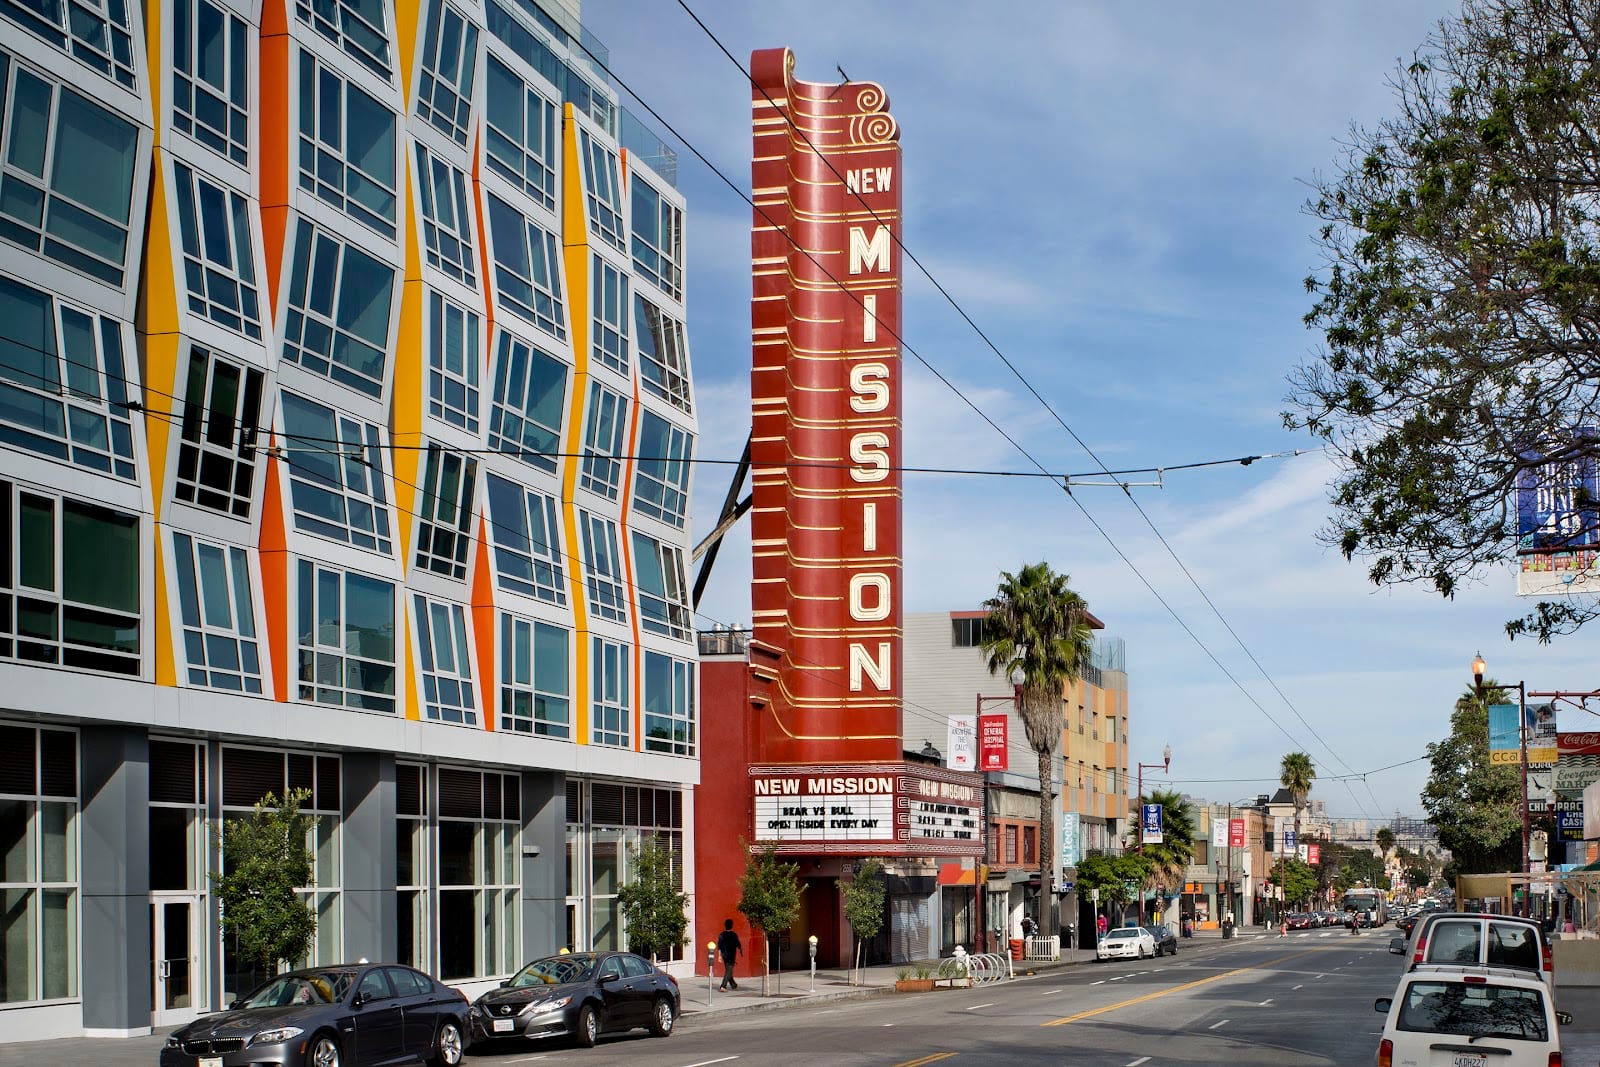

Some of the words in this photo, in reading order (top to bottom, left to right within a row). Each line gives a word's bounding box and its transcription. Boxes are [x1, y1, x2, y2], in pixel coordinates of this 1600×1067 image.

[847, 167, 892, 194] NEW
[849, 225, 892, 692] MISSION
[754, 778, 800, 795] NEW
[807, 777, 893, 794] MISSION
[919, 780, 939, 797] NEW
[1556, 780, 1596, 789] MARK
[783, 807, 808, 816] BEAR
[813, 807, 825, 815] VS
[831, 807, 853, 815] BULL
[768, 820, 791, 829] OPEN
[795, 820, 825, 829] INSIDE
[830, 820, 859, 829] EVERY
[862, 819, 879, 828] DAY
